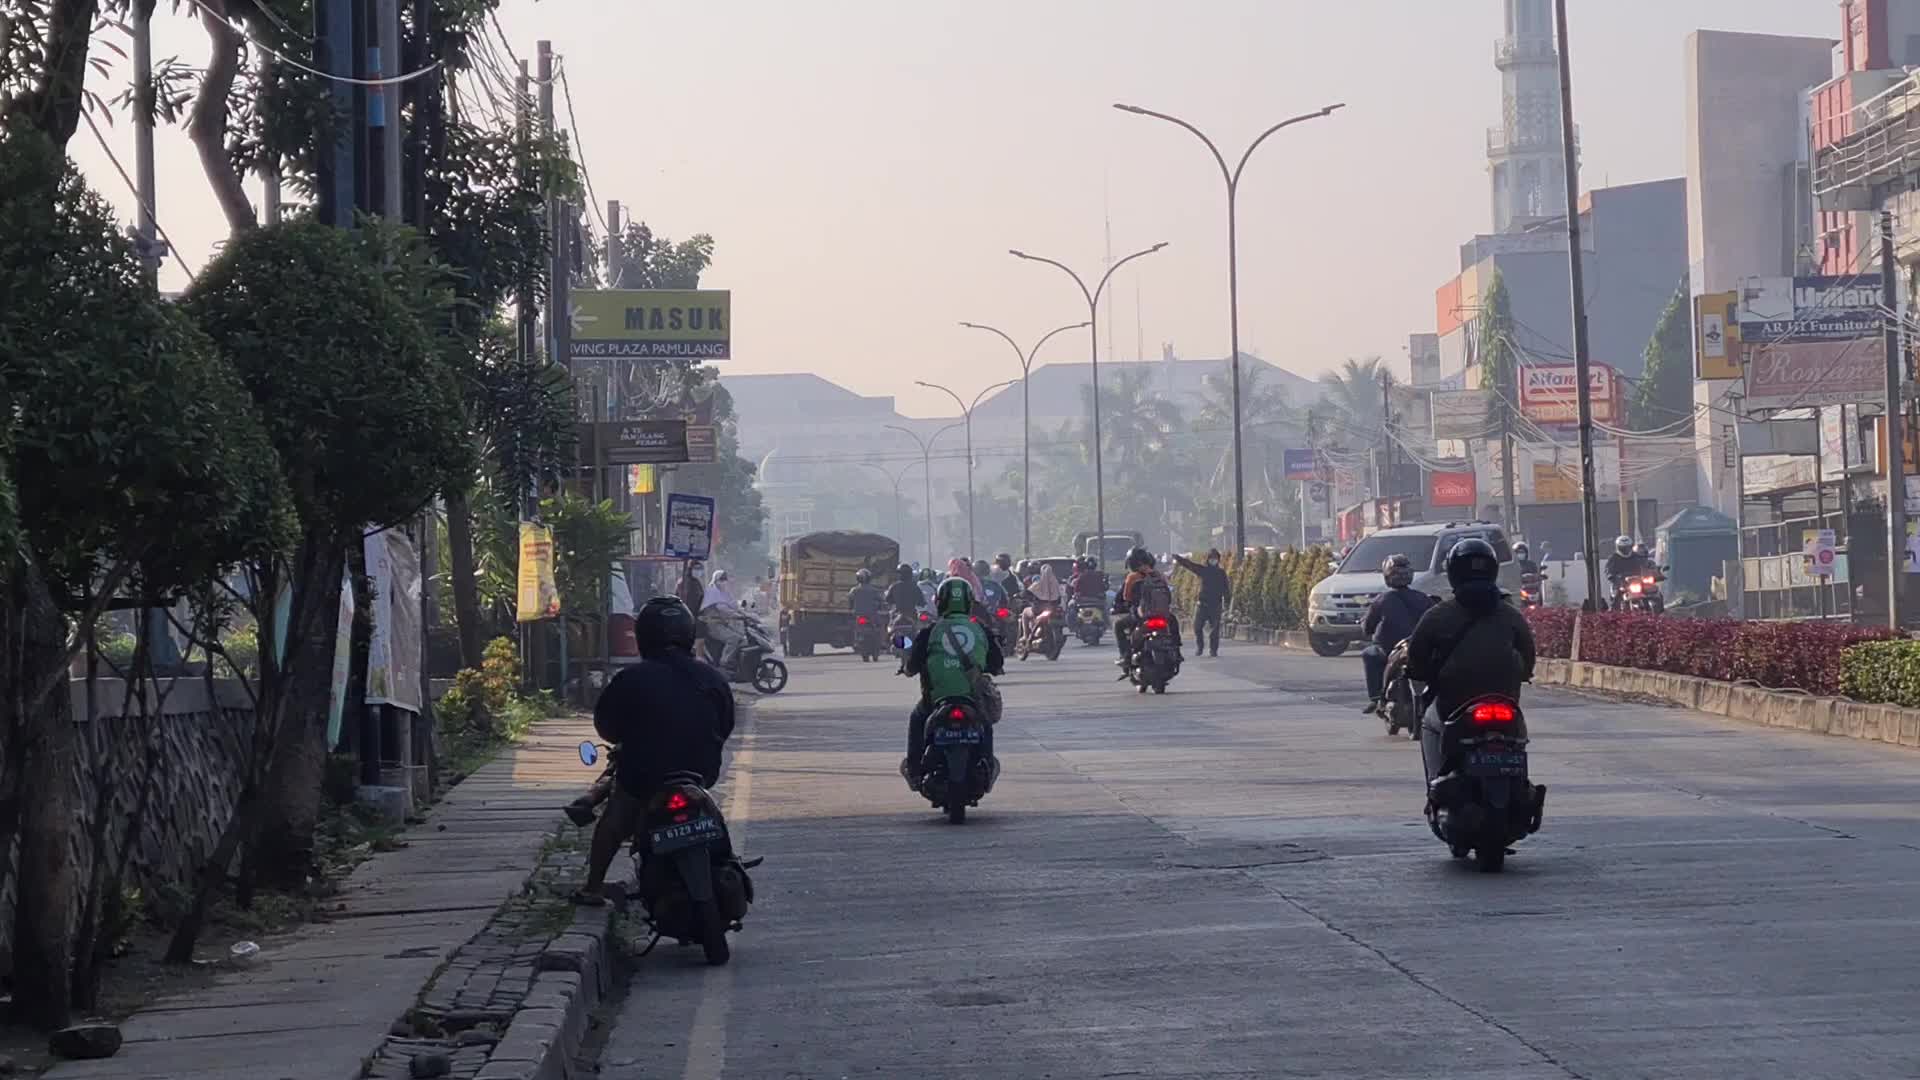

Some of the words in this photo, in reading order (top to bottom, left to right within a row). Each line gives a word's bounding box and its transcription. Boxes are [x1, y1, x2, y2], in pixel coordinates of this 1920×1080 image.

[624, 306, 723, 331] MASUK
[608, 343, 648, 355] PLAZA
[652, 343, 723, 355] PAMULANG
[1529, 370, 1604, 387] Alfamrt
